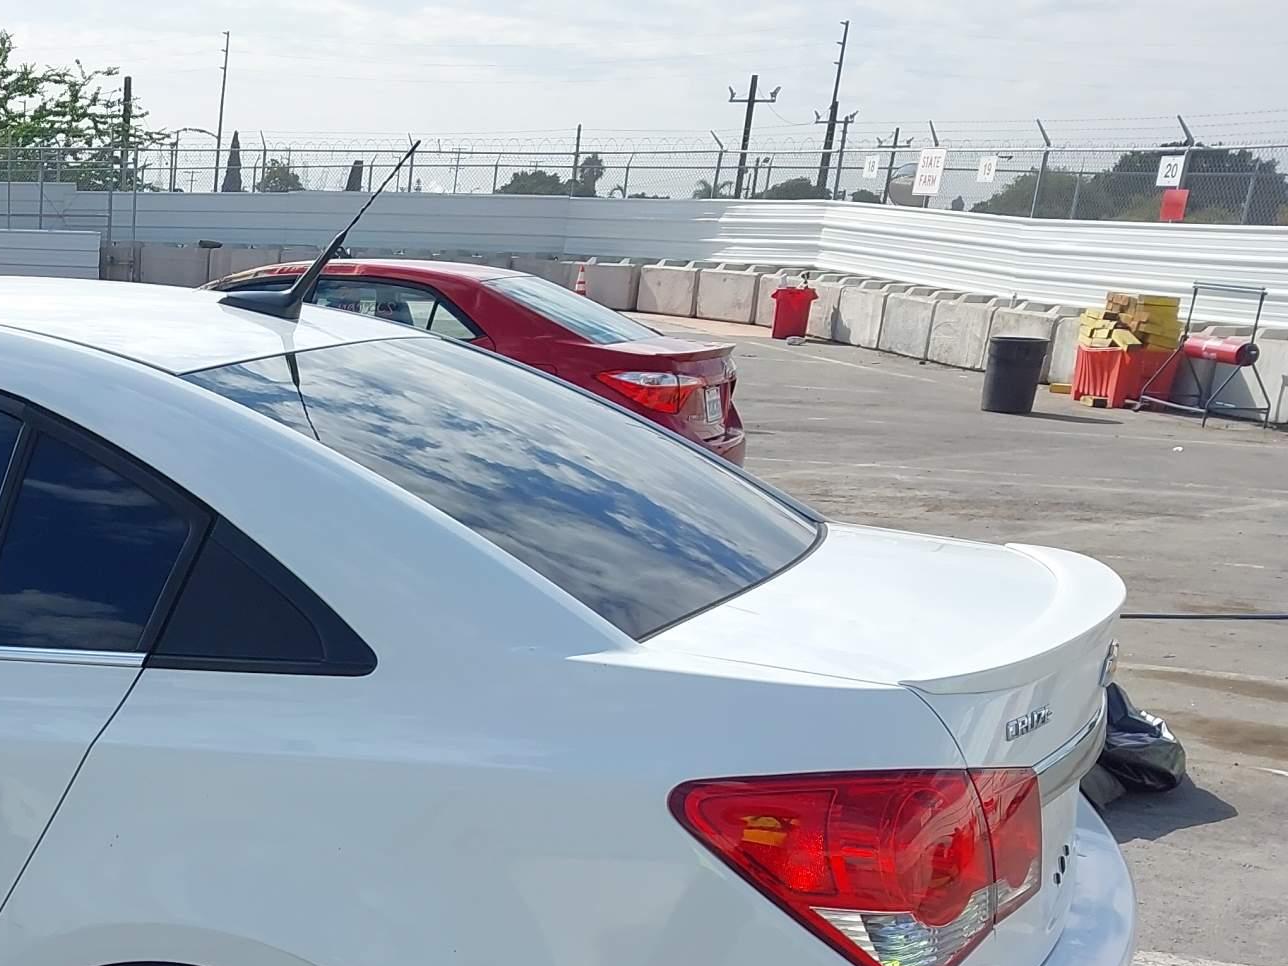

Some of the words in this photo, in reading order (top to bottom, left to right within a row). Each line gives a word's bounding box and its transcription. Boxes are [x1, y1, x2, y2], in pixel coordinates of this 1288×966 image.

[921, 156, 942, 168] STATE
[982, 161, 992, 176] 19
[1163, 163, 1178, 178] 20
[918, 175, 937, 187] FARM
